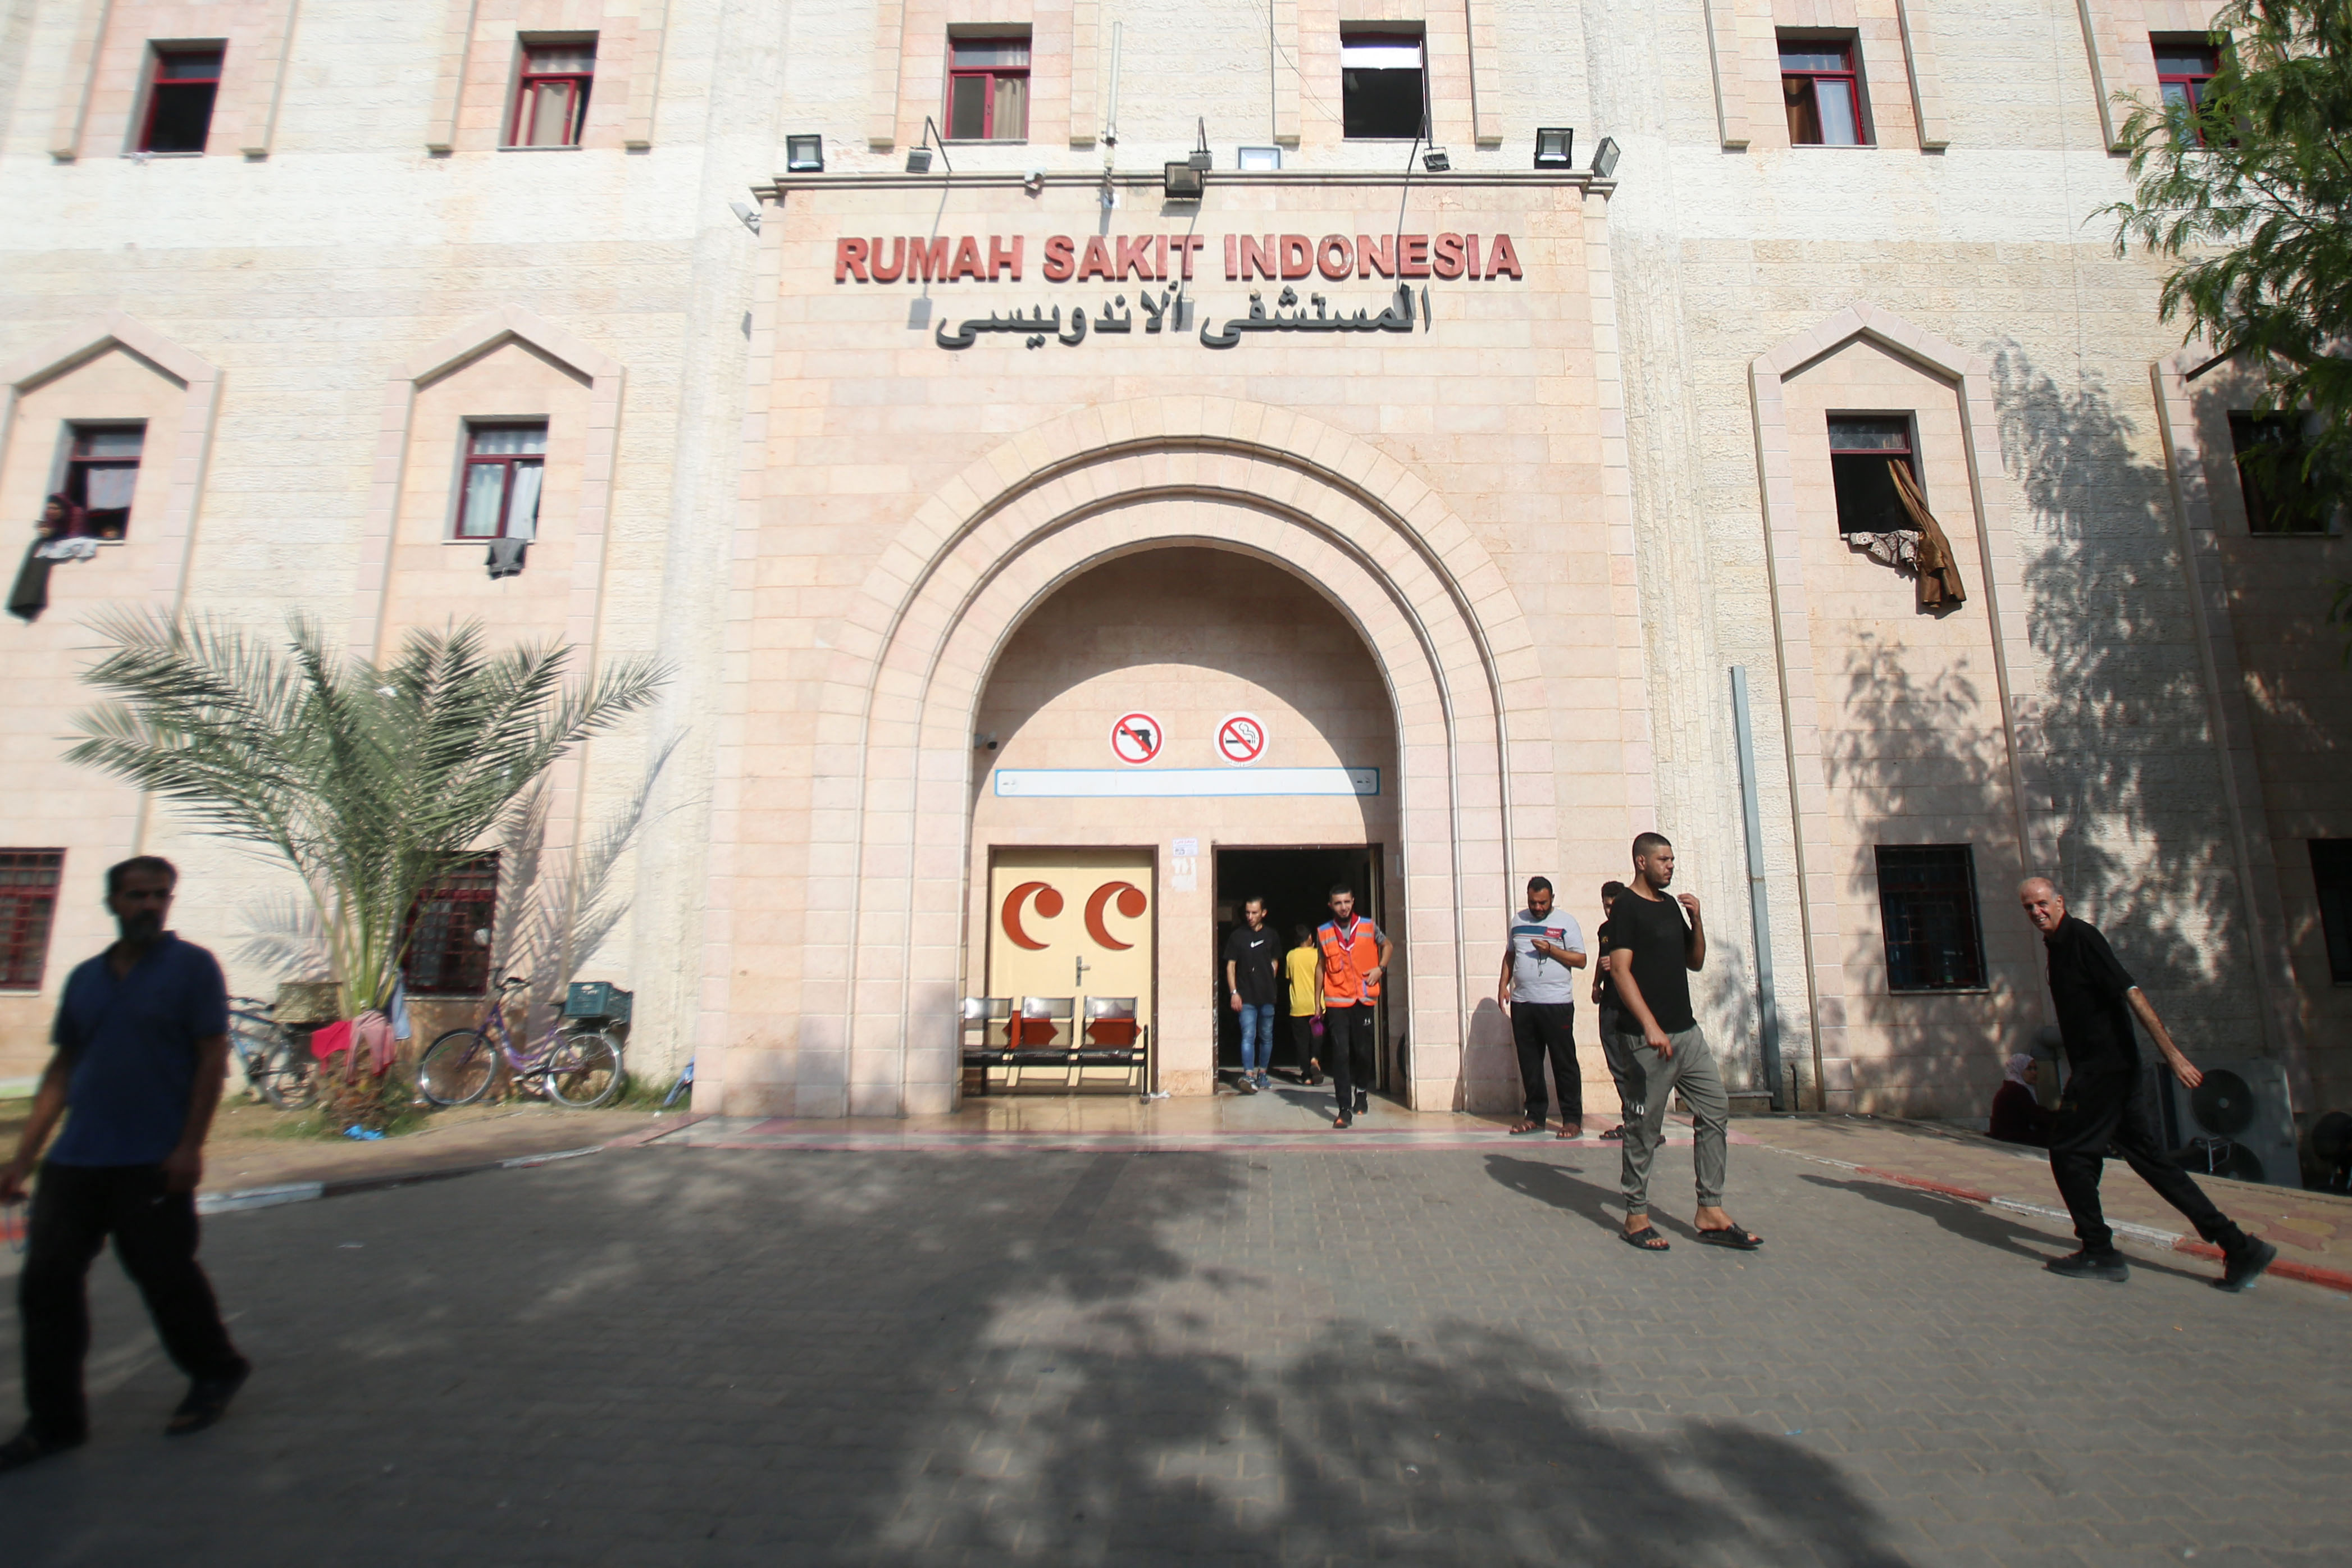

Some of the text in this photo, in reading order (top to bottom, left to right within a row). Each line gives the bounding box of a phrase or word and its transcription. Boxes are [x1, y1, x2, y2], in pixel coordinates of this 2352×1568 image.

[835, 232, 1524, 282] RUMAH SAKIT INDONESIA
[1200, 281, 1432, 349] المستشفى
